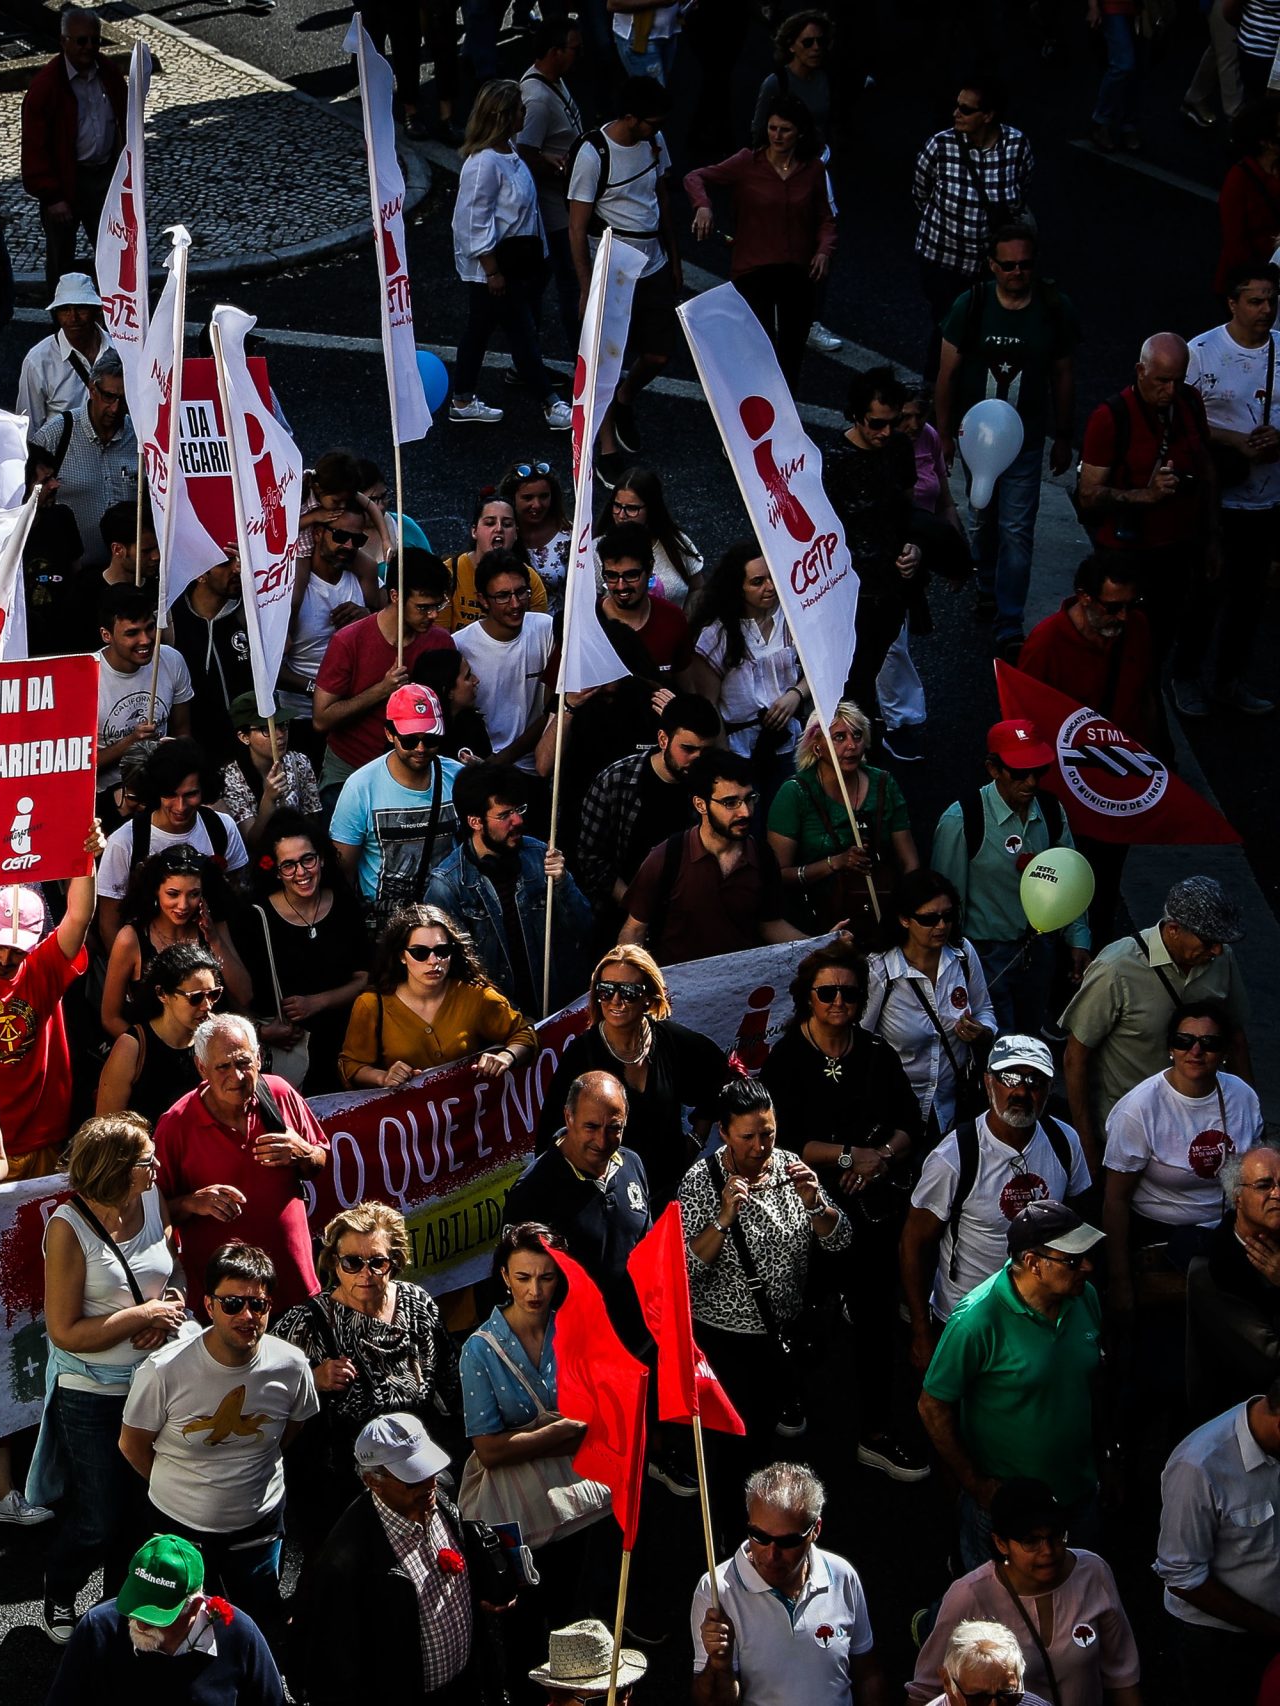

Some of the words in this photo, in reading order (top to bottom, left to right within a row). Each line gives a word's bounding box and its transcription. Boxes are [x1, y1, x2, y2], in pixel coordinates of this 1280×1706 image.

[186, 406, 211, 438] DA
[790, 533, 839, 595] CGTP
[26, 675, 54, 712] DA
[1063, 715, 1091, 744] SINDICATO
[1087, 728, 1131, 743] STML
[1068, 770, 1080, 785] DO
[1129, 800, 1143, 810] DE
[1142, 776, 1165, 805] LISBOA
[1, 854, 42, 871] CGTP
[378, 1098, 464, 1212] QUE
[139, 1568, 176, 1589] Heineken
